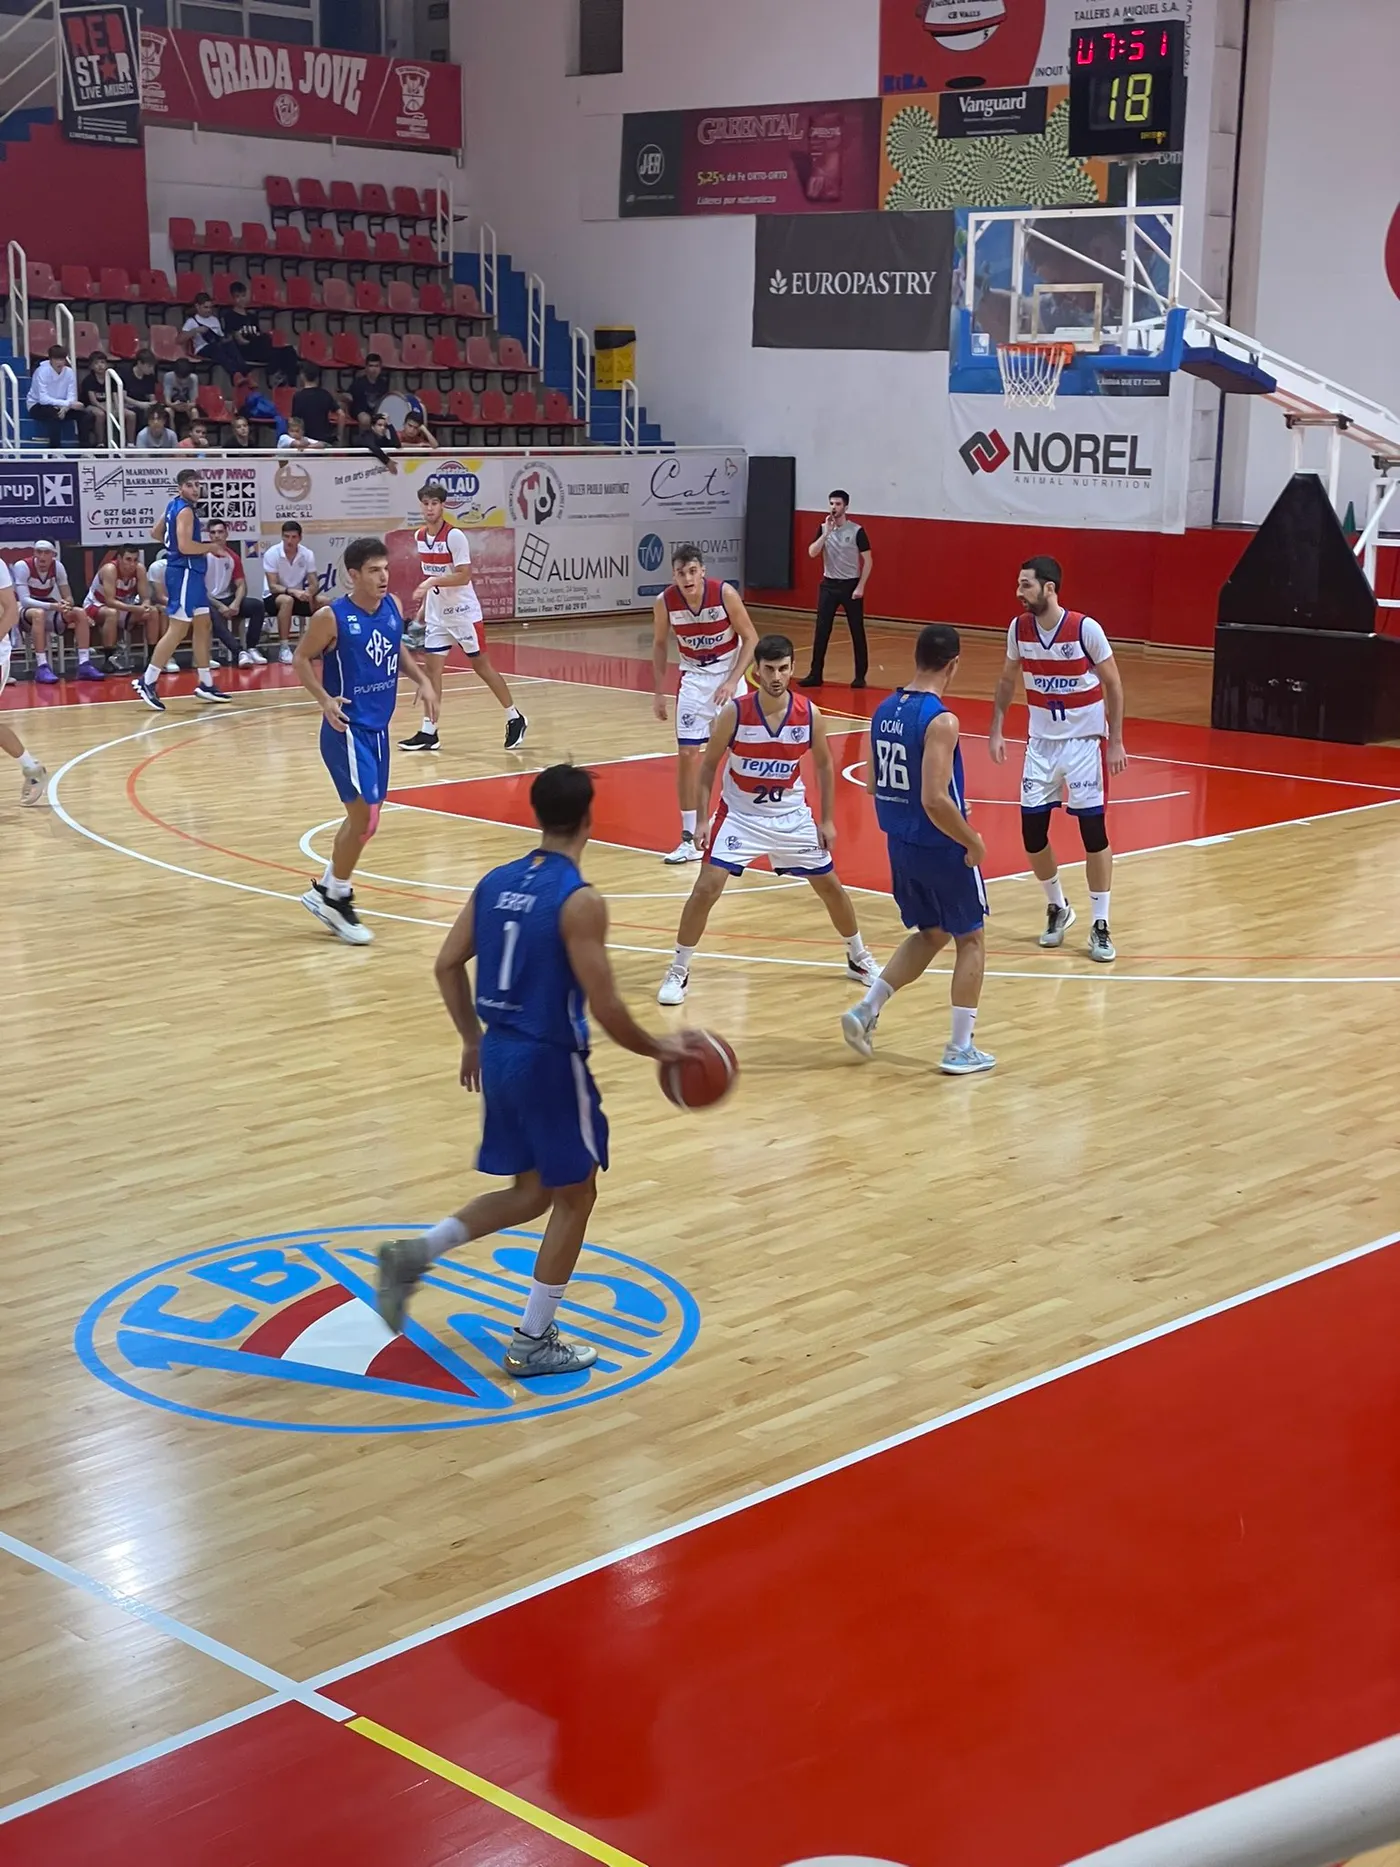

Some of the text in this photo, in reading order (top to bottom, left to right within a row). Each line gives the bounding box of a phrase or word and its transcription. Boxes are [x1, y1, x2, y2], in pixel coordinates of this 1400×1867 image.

[1074, 2, 1179, 21] TALLERS A MIQUEL S.A.
[65, 13, 126, 56] RED
[199, 39, 367, 116] GRADA JOVE
[1035, 66, 1063, 77] INOUT
[80, 82, 134, 100] LIVE MUSIC
[1109, 73, 1153, 122] 18
[959, 91, 1027, 117] Vanguard
[697, 113, 804, 145] GREENTAL
[791, 271, 937, 296] EUROPASTRY
[1013, 431, 1152, 477] NOREL
[125, 468, 163, 476] MARIMON
[1014, 476, 1151, 489] ANIMAL NUTRITION
[0, 484, 35, 501] rup
[429, 477, 476, 493] PALAU
[43, 515, 75, 524] DIGITAL
[104, 508, 119, 516] 627
[121, 508, 136, 516] 648
[121, 517, 136, 525] 601
[105, 530, 145, 539] VALL
[547, 555, 629, 582] ALUMINI
[365, 628, 393, 667] CBS
[387, 653, 398, 676] 14
[1047, 700, 1066, 722] 11
[876, 740, 910, 786] 86
[753, 784, 785, 804] 20
[498, 921, 521, 991] 1
